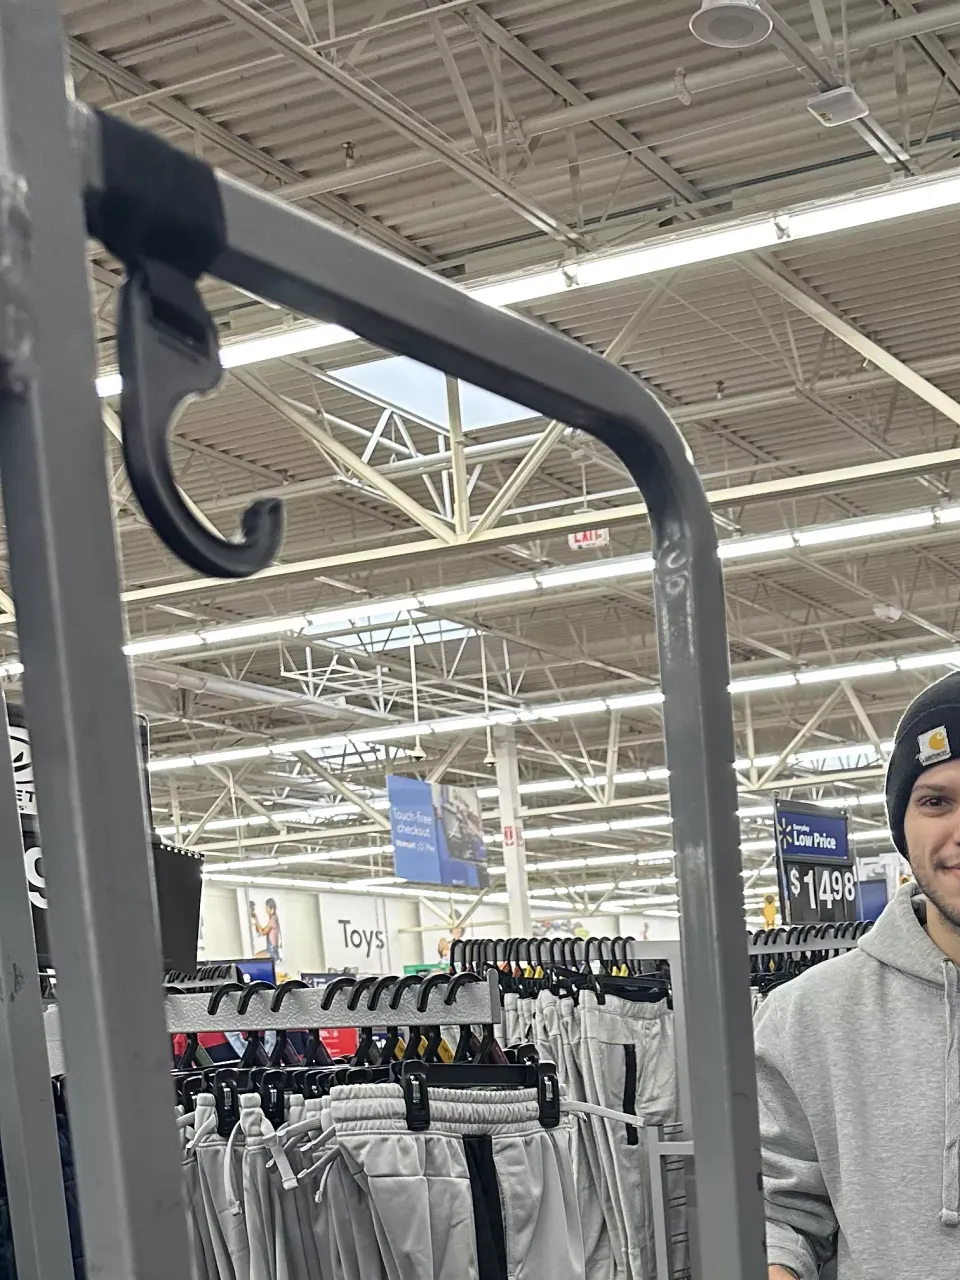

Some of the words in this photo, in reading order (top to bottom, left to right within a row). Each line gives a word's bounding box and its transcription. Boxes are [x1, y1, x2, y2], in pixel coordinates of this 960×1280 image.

[793, 830, 813, 848] Low
[814, 832, 836, 849] Price
[337, 919, 385, 958] Toys
